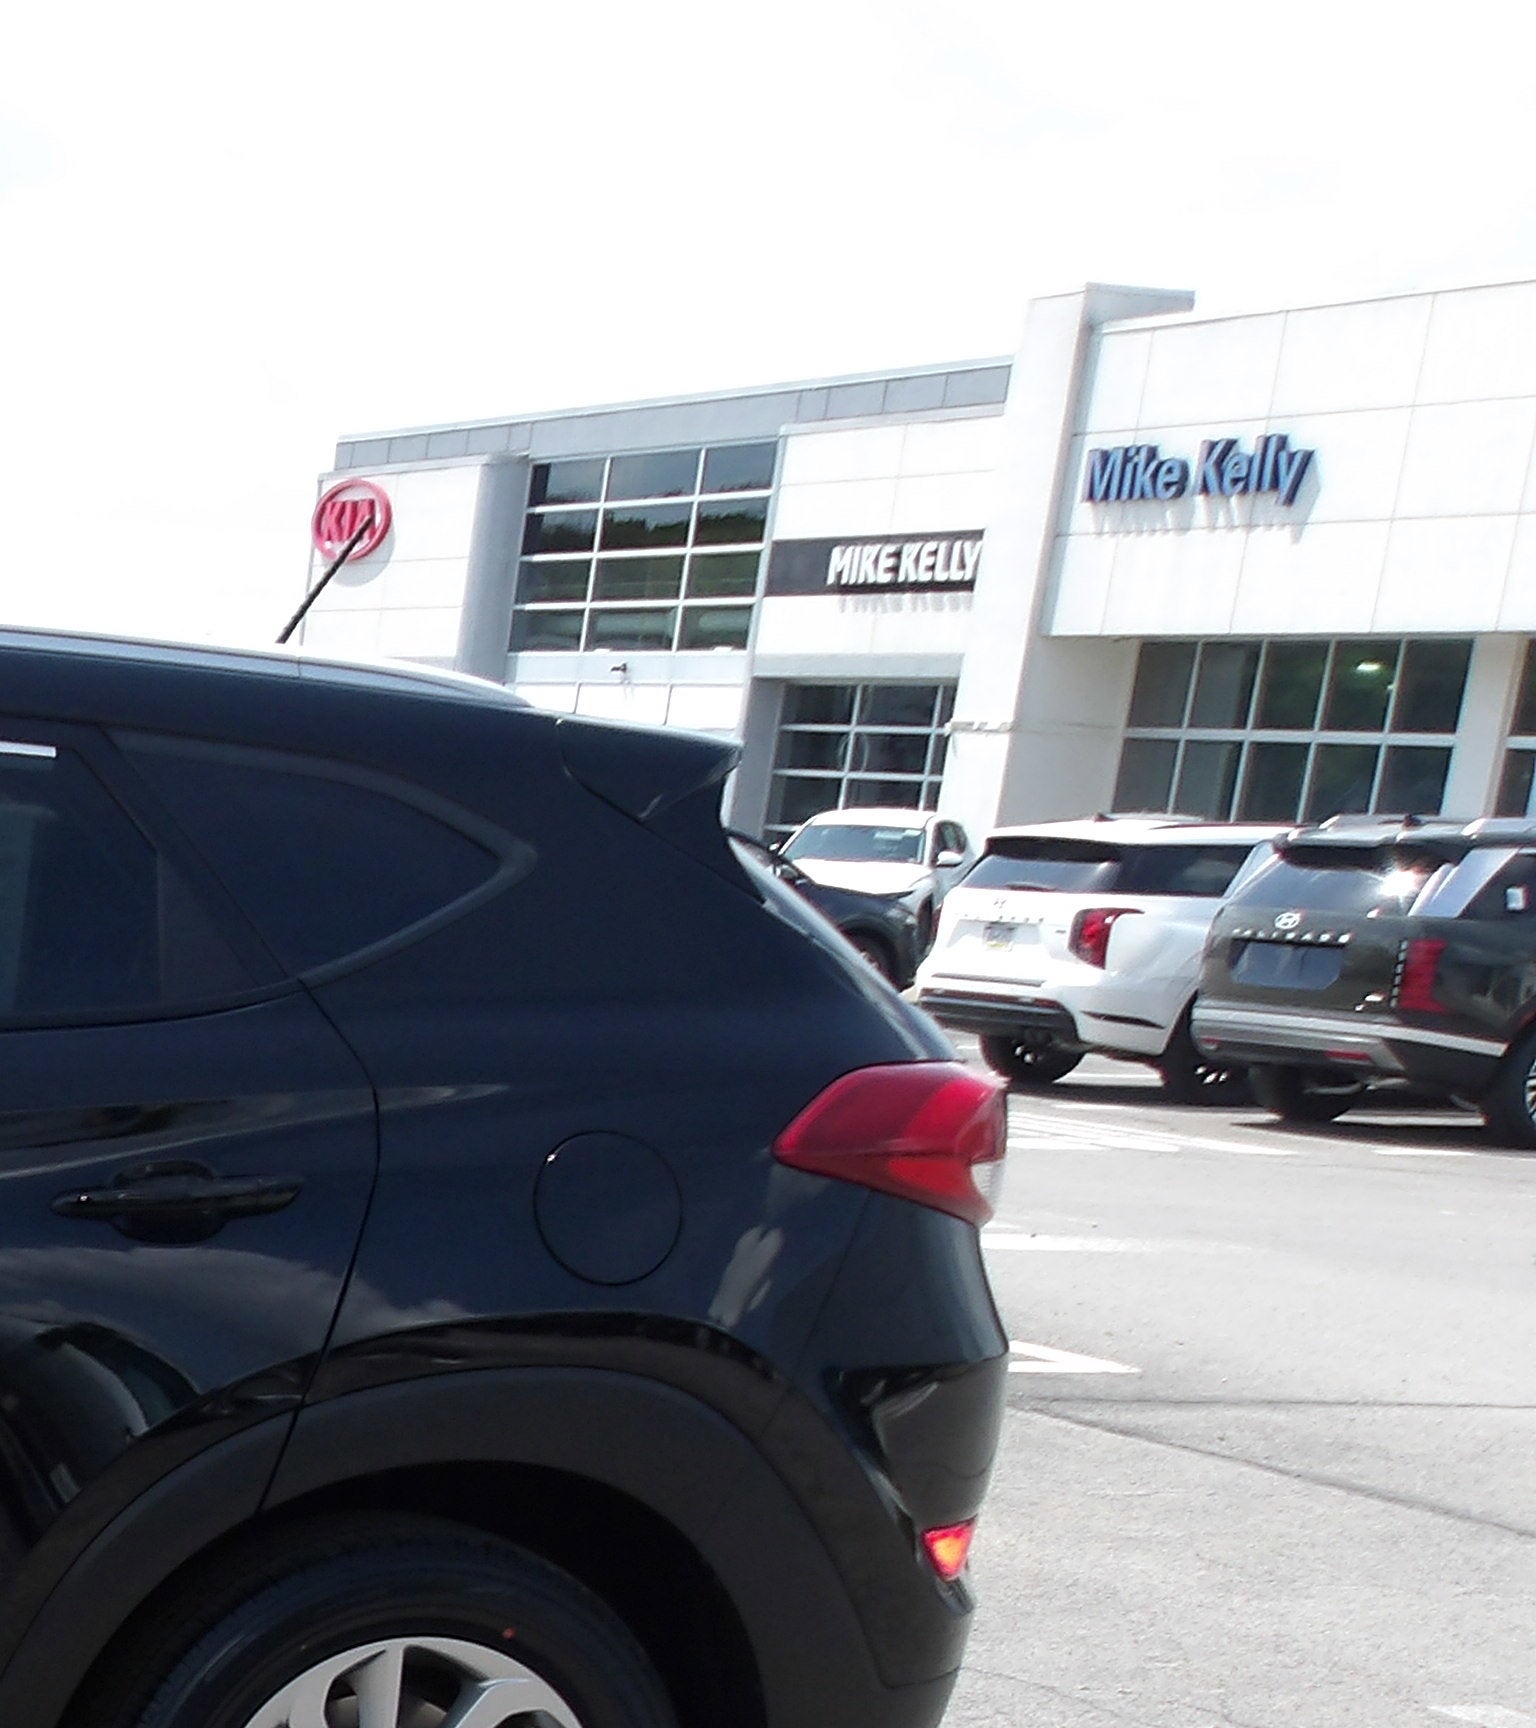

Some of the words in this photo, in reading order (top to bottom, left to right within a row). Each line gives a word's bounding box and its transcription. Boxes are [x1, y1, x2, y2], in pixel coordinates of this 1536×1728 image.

[1081, 444, 1190, 503] Mike
[1194, 433, 1316, 507] Kelly
[827, 544, 898, 585] MIKE
[897, 540, 983, 582] KELLY
